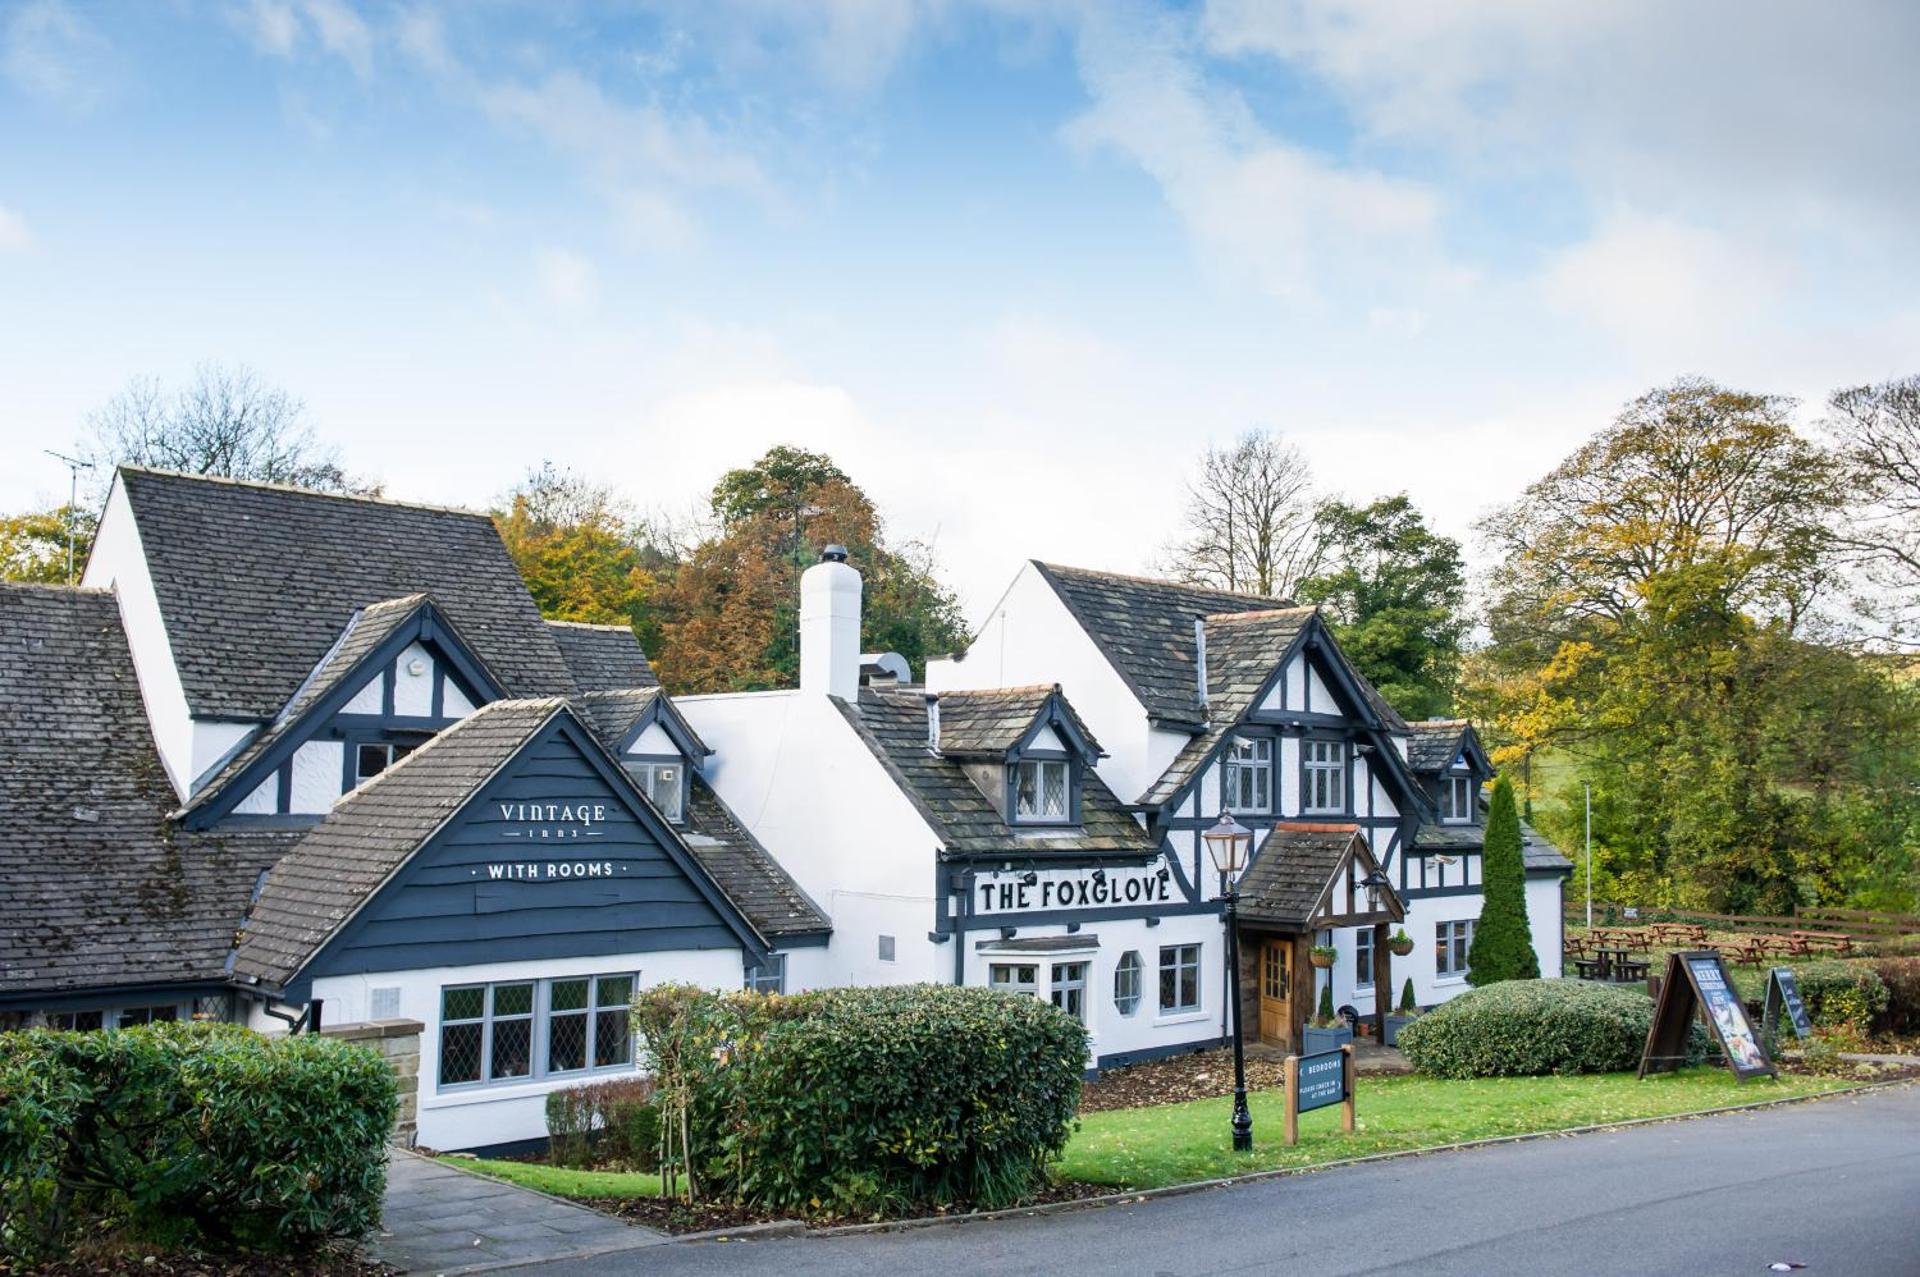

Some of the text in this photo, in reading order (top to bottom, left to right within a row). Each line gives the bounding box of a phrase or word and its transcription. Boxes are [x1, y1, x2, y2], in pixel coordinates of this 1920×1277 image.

[500, 804, 605, 826] VINTAGE
[529, 829, 577, 838] INNS
[488, 862, 612, 879] WITH ROOMS
[980, 878, 1169, 910] THE FOXGLOVE
[1308, 1059, 1340, 1074] BEDROOMS
